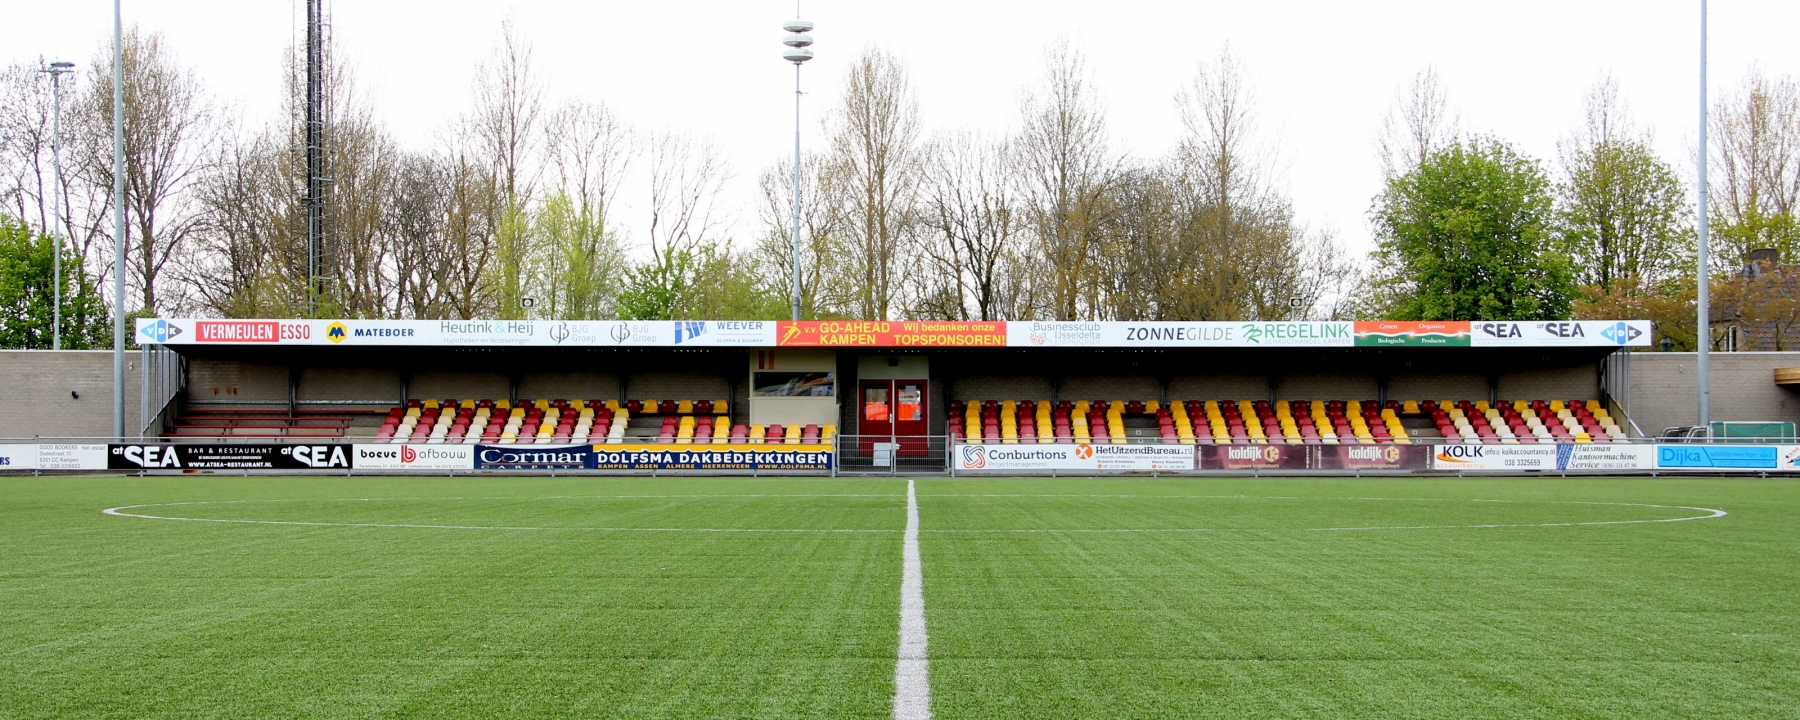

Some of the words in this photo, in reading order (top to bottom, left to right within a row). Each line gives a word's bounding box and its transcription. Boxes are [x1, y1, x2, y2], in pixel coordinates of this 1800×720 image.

[440, 321, 492, 334] Heutink
[495, 321, 506, 334] &
[508, 321, 534, 336] Heij
[572, 324, 588, 333] BJG
[632, 324, 649, 333] BJG
[716, 321, 763, 330] WEEVER
[819, 322, 891, 333] GO-AHEAD
[903, 322, 919, 333] Wij
[921, 322, 969, 332] bedanken
[971, 324, 996, 332] onze
[1033, 322, 1101, 331] Businessclub
[1264, 323, 1350, 338] REGELINK
[1482, 323, 1523, 338] SEA
[1544, 322, 1585, 338] SEA
[202, 324, 273, 339] VERMEULEN
[280, 324, 311, 340] ESSO
[354, 328, 414, 337] MATEBOER
[1126, 327, 1234, 341] ZONNEGILDE
[572, 334, 596, 343] Groep
[632, 334, 657, 343] Groep
[820, 334, 876, 345] KAMPEN
[893, 334, 1006, 345] TOPSPONSOREN!
[360, 449, 397, 459] boeve
[418, 448, 466, 459] afbouw
[1095, 446, 1193, 455] HetUitzendBureau.nl
[1228, 446, 1262, 461] koldijk
[1348, 446, 1382, 461] koldijk
[1443, 445, 1484, 457] KOLK
[1501, 448, 1556, 456] kolkaccountancy.nl
[1574, 444, 1611, 452] Huisman
[112, 446, 124, 455] at
[124, 445, 181, 468] SEA
[280, 446, 292, 455] at
[292, 445, 349, 468] SEA
[480, 449, 587, 463] Cormar
[597, 453, 673, 464] DOLFSMA
[680, 453, 828, 464] DAKBEDEKKINGEN
[989, 449, 1067, 460] Conburtions
[1661, 448, 1701, 465] Dijka
